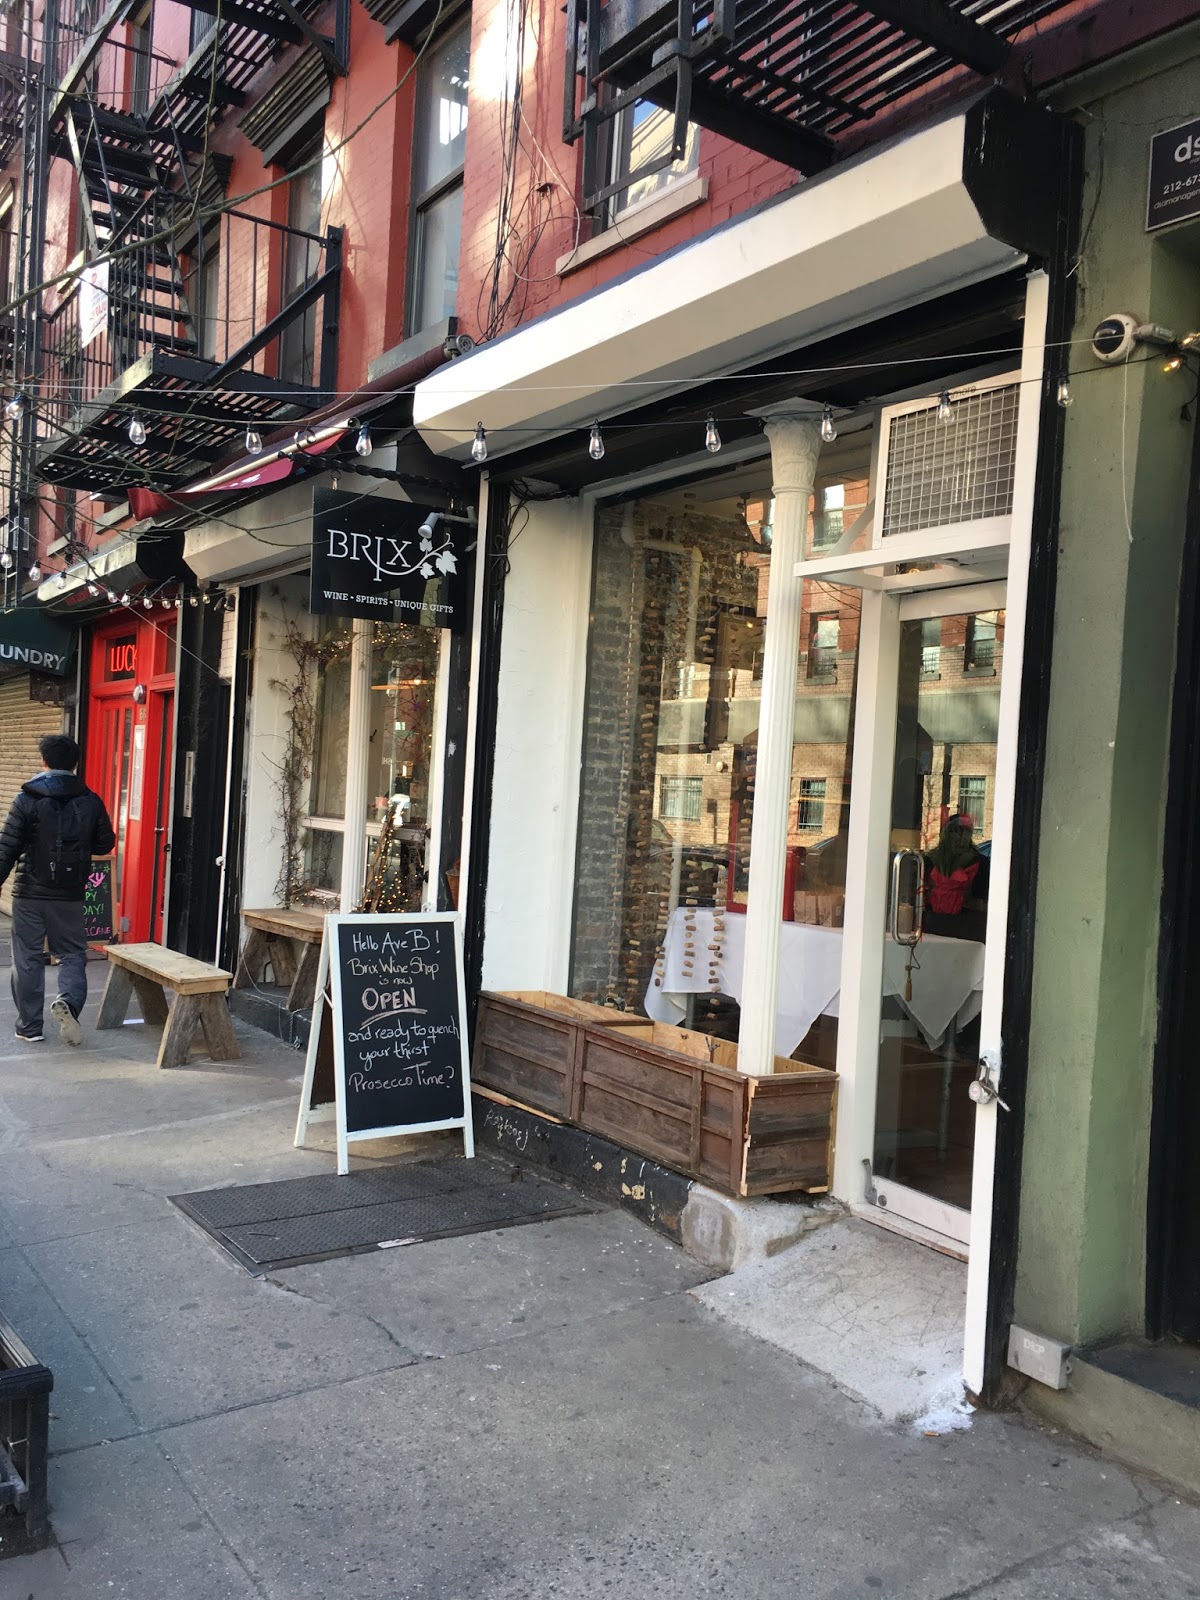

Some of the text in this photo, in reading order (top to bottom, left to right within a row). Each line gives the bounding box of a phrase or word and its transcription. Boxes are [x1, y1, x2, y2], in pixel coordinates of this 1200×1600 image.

[1163, 174, 1200, 195] 212-67
[326, 528, 413, 582] BRIX
[323, 590, 454, 614] WINE SPIRITS UNIQUE GIFTS
[0, 643, 66, 671] UNDRY
[352, 931, 379, 953] Hello
[381, 931, 408, 955] Ave
[347, 956, 440, 980] Brix Wine Shop
[379, 975, 413, 985] is now
[348, 1015, 460, 1044] and ready to quench
[359, 1040, 430, 1072] your thirst
[348, 1071, 413, 1093] Prosecco
